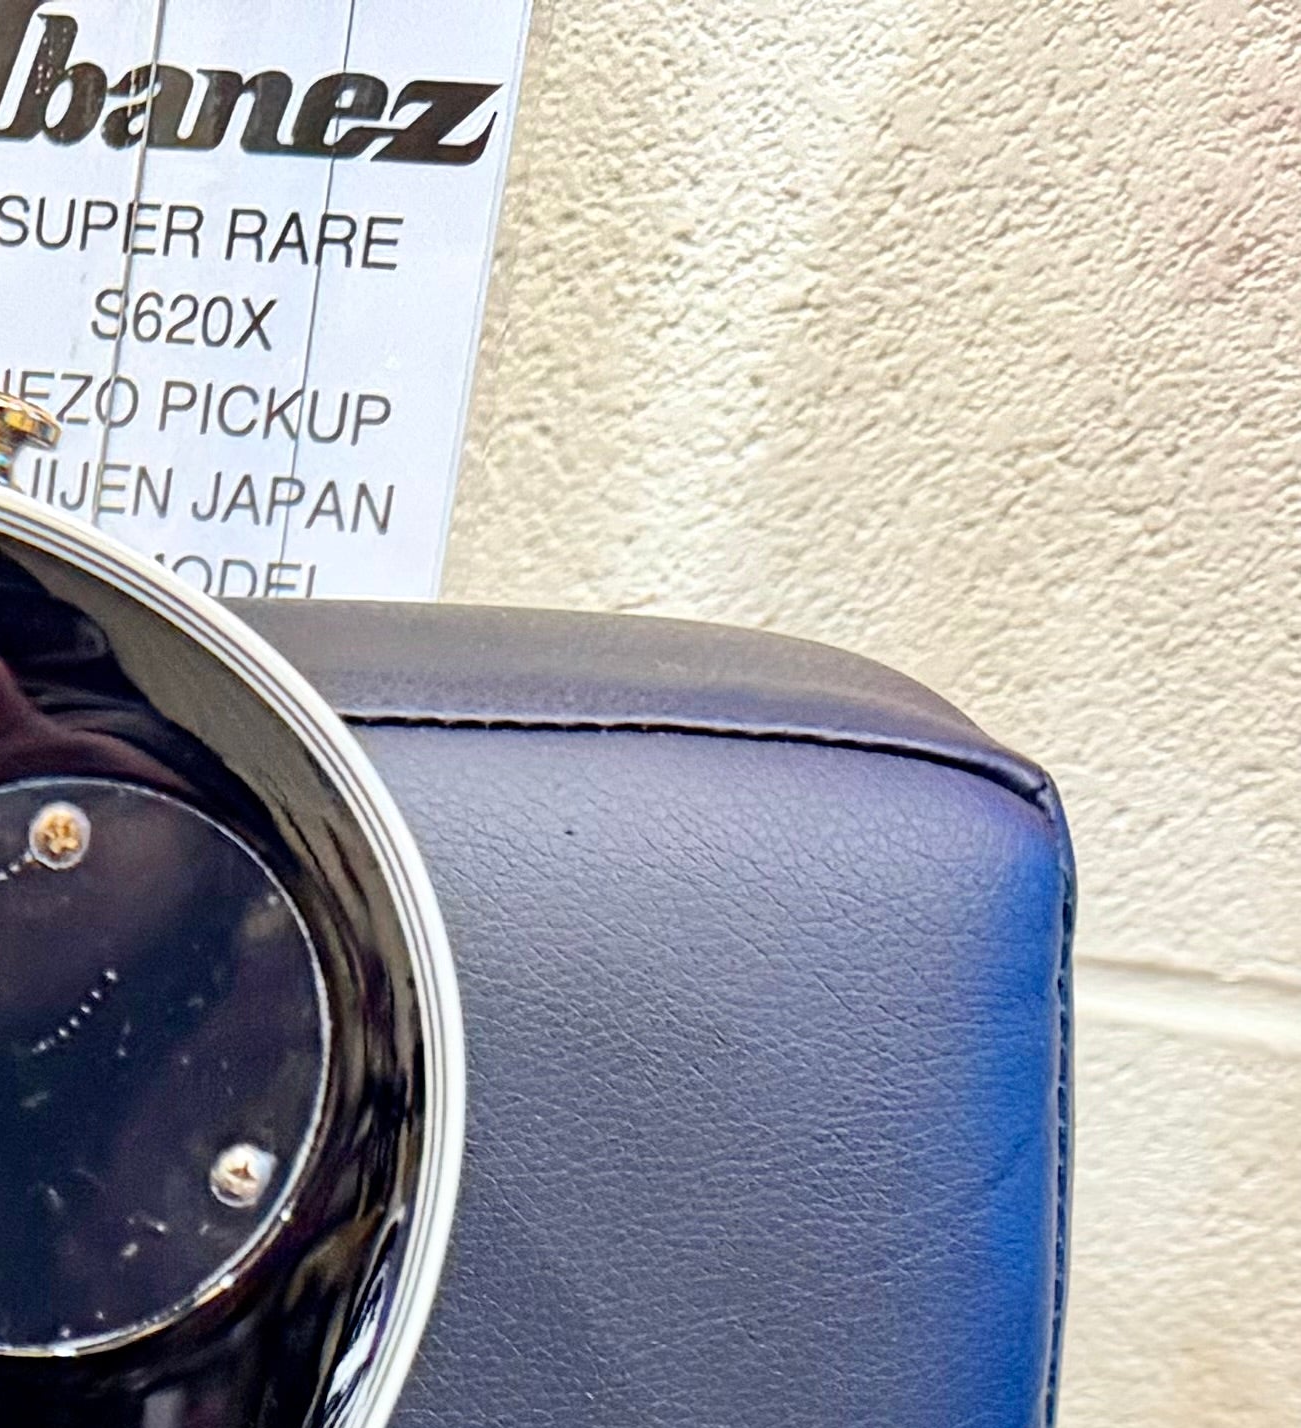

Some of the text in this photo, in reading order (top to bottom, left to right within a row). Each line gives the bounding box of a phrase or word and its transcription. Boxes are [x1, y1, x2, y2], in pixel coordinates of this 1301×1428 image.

[225, 208, 404, 271] RARE
[91, 288, 278, 352] S620X
[158, 380, 392, 447] PICKUP
[191, 470, 395, 535] JAPAN
